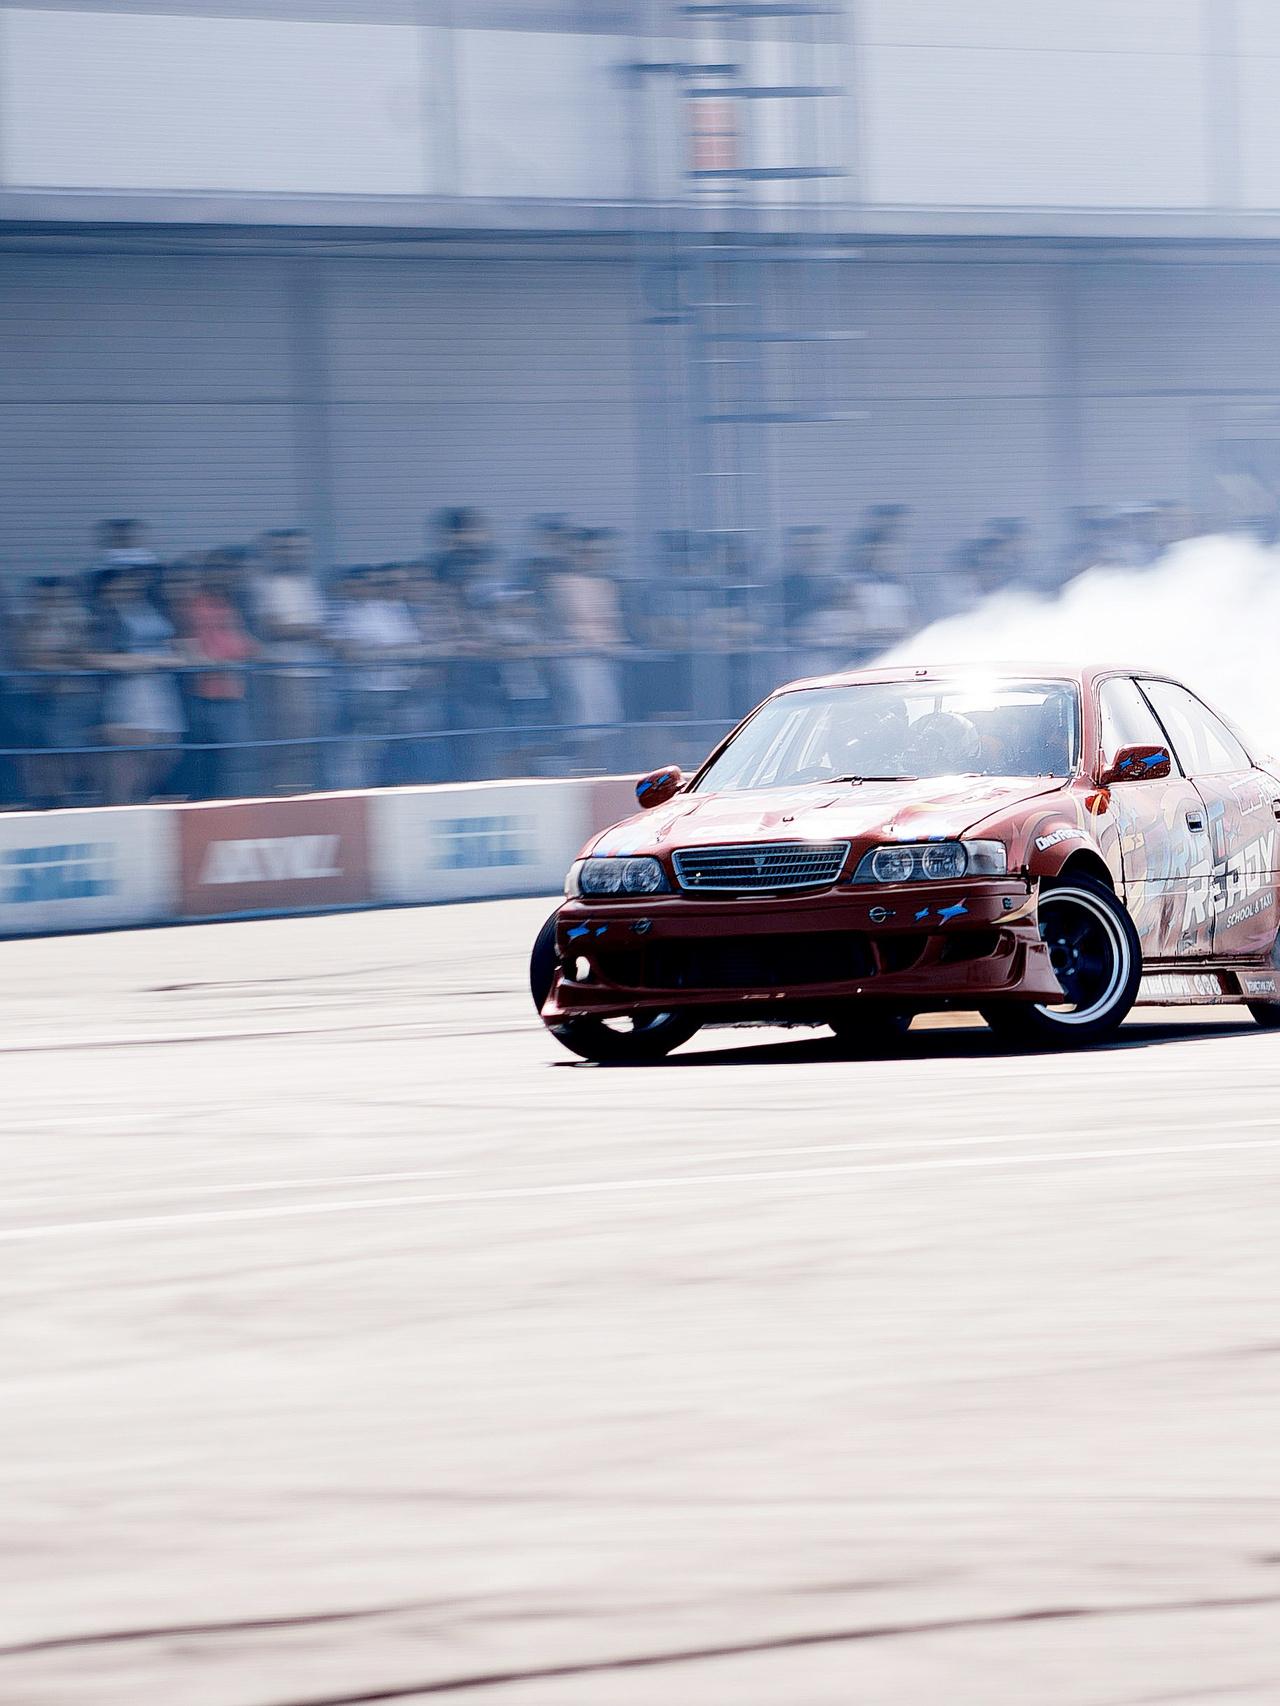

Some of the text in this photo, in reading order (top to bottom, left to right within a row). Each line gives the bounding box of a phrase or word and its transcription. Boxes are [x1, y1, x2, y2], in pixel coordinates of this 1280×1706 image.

[1181, 828, 1276, 932] READY
[1226, 892, 1273, 929] SCHOOL & TAXI
